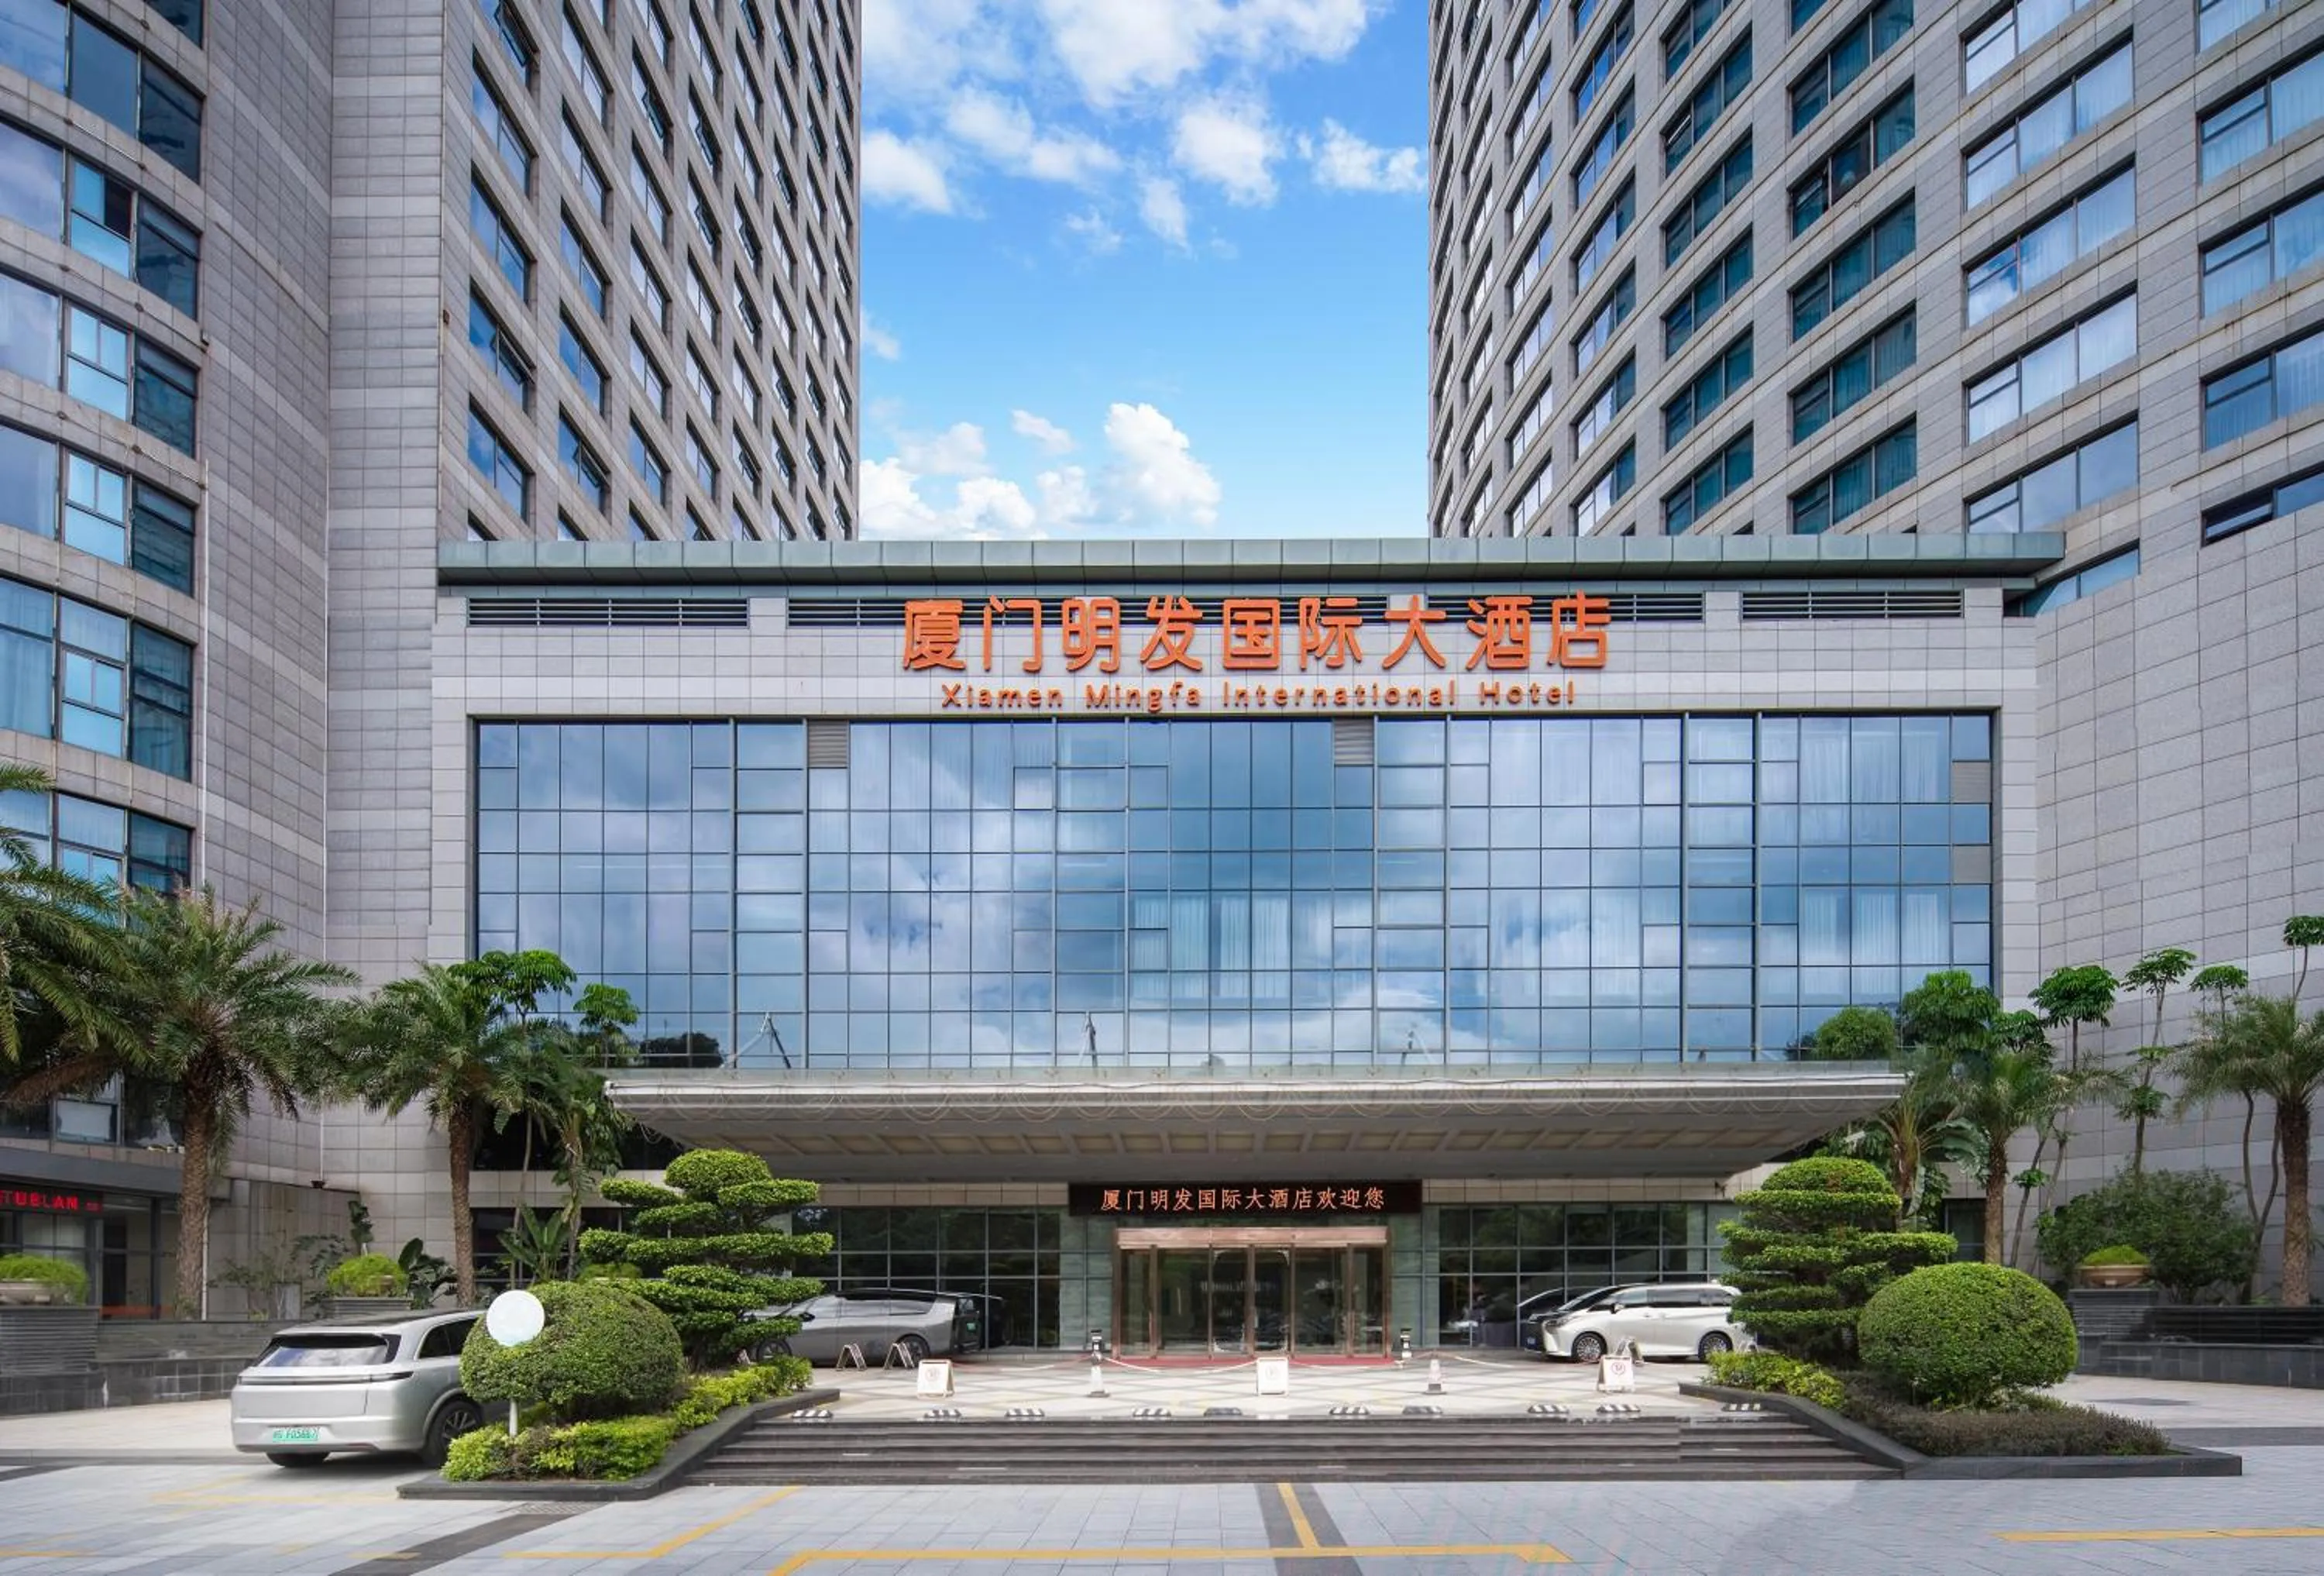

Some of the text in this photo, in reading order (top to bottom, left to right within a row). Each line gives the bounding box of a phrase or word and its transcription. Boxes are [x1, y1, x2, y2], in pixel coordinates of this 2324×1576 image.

[902, 591, 1612, 673] 厦门明发国际大酒店
[941, 680, 1576, 714] Xiamen Mingfa International Hotel
[1100, 1187, 1385, 1212] 厦门明发国际大酒店欢迎您
